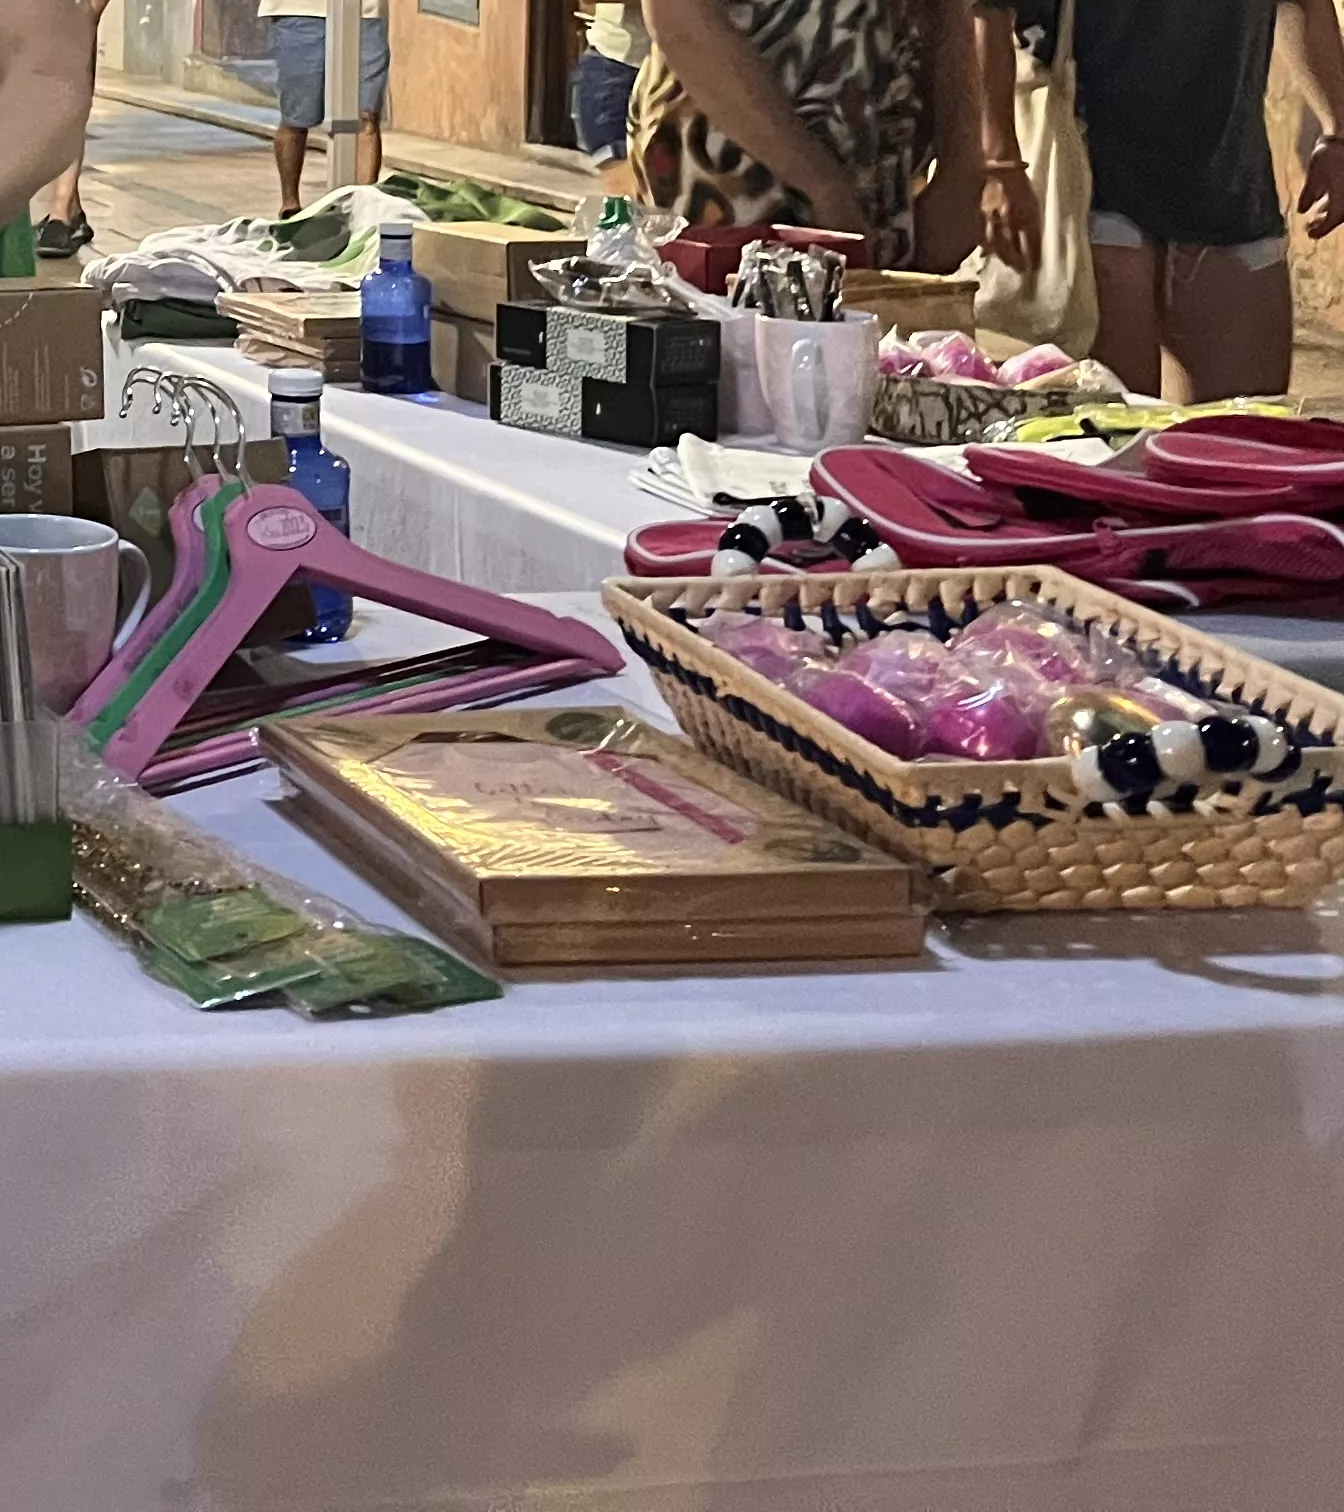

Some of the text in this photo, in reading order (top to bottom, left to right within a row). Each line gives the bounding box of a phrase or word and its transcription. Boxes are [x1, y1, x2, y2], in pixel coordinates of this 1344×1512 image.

[1, 446, 16, 506] a ser
[23, 444, 47, 494] Hoy
